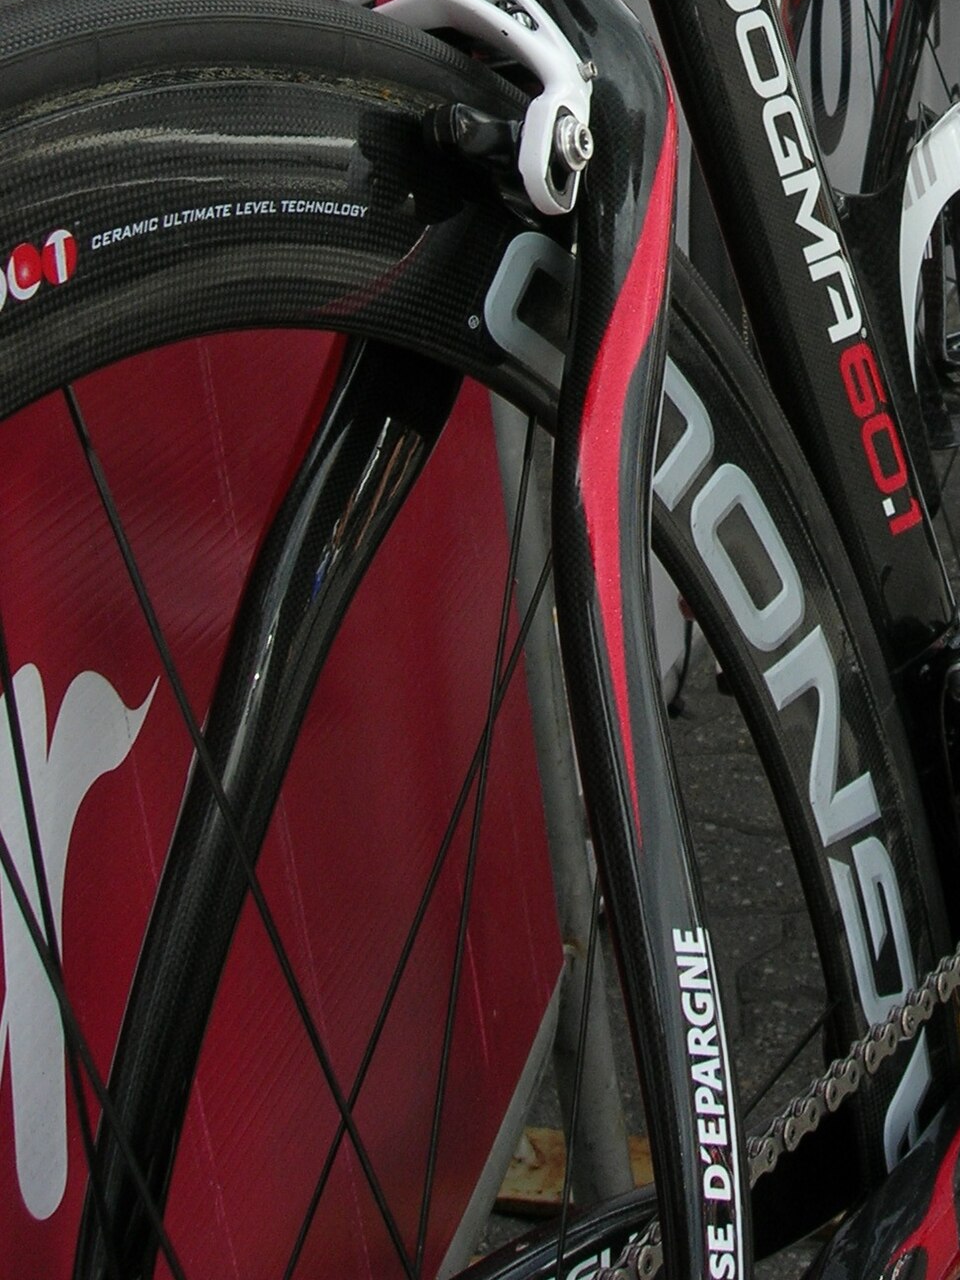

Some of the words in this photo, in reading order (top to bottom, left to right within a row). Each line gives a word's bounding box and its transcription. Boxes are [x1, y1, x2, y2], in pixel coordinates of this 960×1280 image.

[91, 218, 159, 251] CERAMIC
[163, 204, 232, 229] ULTIMATE
[235, 200, 277, 216] LEVEL
[281, 200, 369, 219] TECHNOLOGY
[840, 341, 923, 535] 60.1
